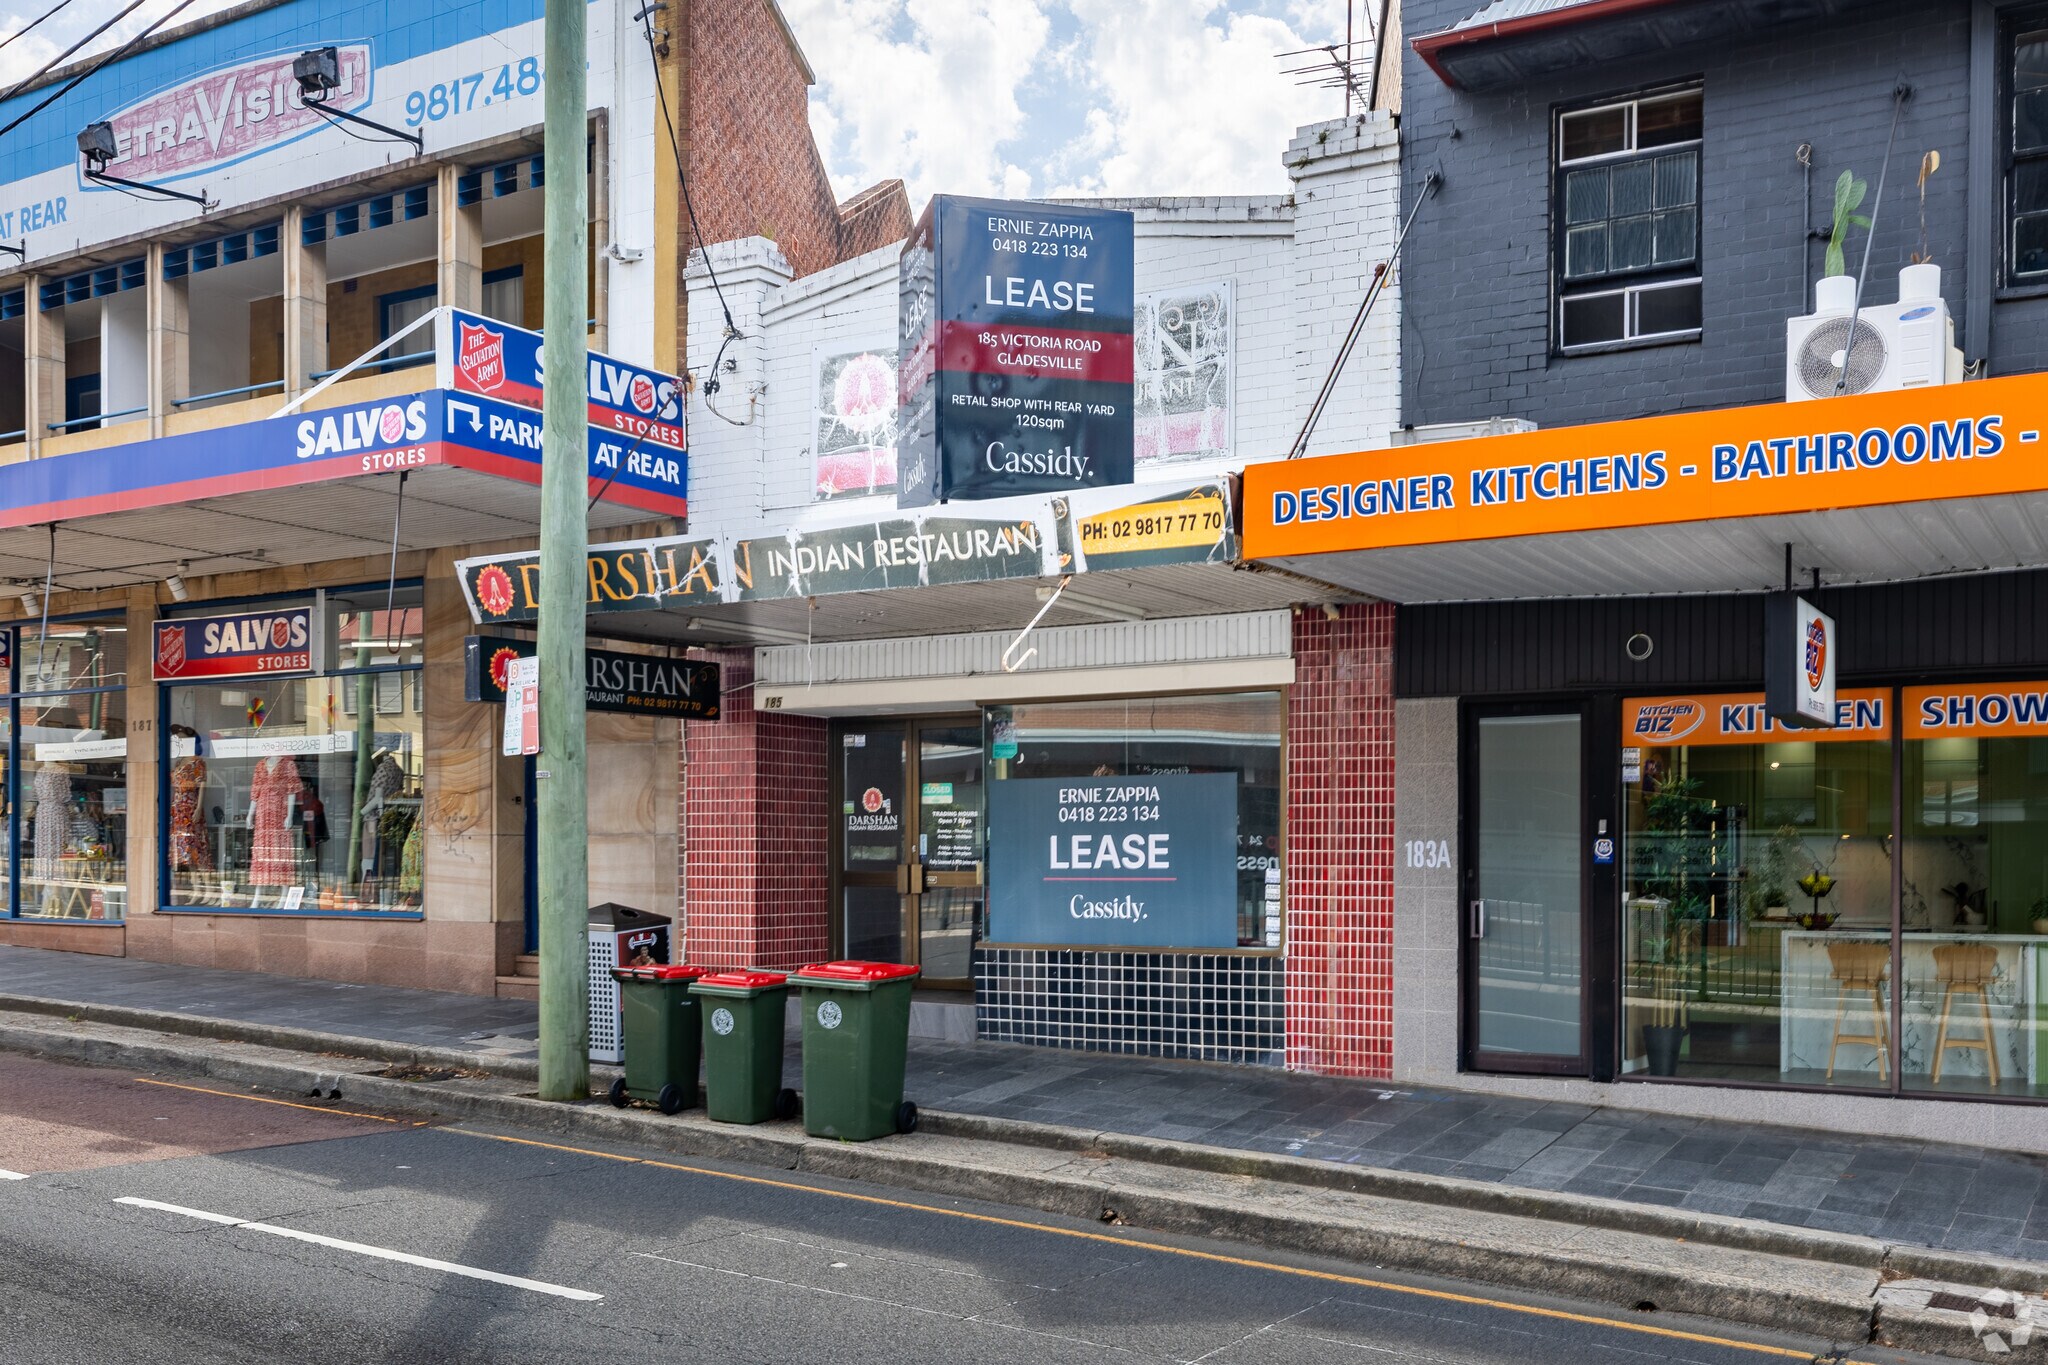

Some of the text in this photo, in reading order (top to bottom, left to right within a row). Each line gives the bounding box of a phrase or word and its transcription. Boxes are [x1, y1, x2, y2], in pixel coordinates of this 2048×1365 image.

[405, 56, 599, 127] 9817.48
[20, 196, 67, 234] REAR
[988, 217, 1094, 241] ERNIE ZAPPIA
[992, 238, 1088, 259] 0418 223 134
[985, 275, 1095, 313] LEASE
[904, 285, 928, 340] LEASE
[468, 332, 486, 350] THE
[977, 331, 1102, 352] 185 VICTORIA ROAD
[462, 339, 501, 370] SALVATION
[997, 352, 1083, 370] GLADESVILLE
[477, 359, 499, 384] ARMY
[535, 345, 679, 421] LVOS
[952, 394, 1115, 416] RETAIL SHOP WITH REAR YARD
[296, 400, 427, 459] SALVOS
[614, 413, 680, 445] STORES
[1016, 414, 1065, 430] 120sqm
[362, 447, 426, 471] STORES
[489, 414, 680, 485] PARK AT REAR
[985, 441, 1094, 481] Cassidy.
[1273, 474, 1454, 525] DESIGNER
[1470, 451, 1668, 506] KITCHENS
[1712, 414, 2005, 482] BATHROOMS
[1082, 511, 1221, 540] PH: 02 9817 77 70
[517, 525, 1037, 609] DRSHAN INDIAN RESTAURAN
[163, 631, 175, 646] THE
[204, 615, 308, 655] SALVOS
[257, 654, 308, 670] STORES
[586, 656, 692, 697] RSHAN
[586, 690, 701, 711] TAURANT PH: 02 9817 77 70
[765, 696, 783, 708] 185
[1639, 704, 1694, 717] KITCHEN
[132, 720, 152, 731] 187
[1634, 715, 1676, 735] BIZ
[1721, 698, 1883, 735] KITEN
[923, 786, 950, 794] CLOSED
[1059, 786, 1160, 804] ERNIE ZAPPIA
[848, 815, 898, 825] DARSHAN
[1058, 805, 1160, 823] 0418 223 134
[1050, 833, 1170, 870] LEASE
[1405, 840, 1451, 868] 183A
[1070, 893, 1148, 924] Cassidy.
